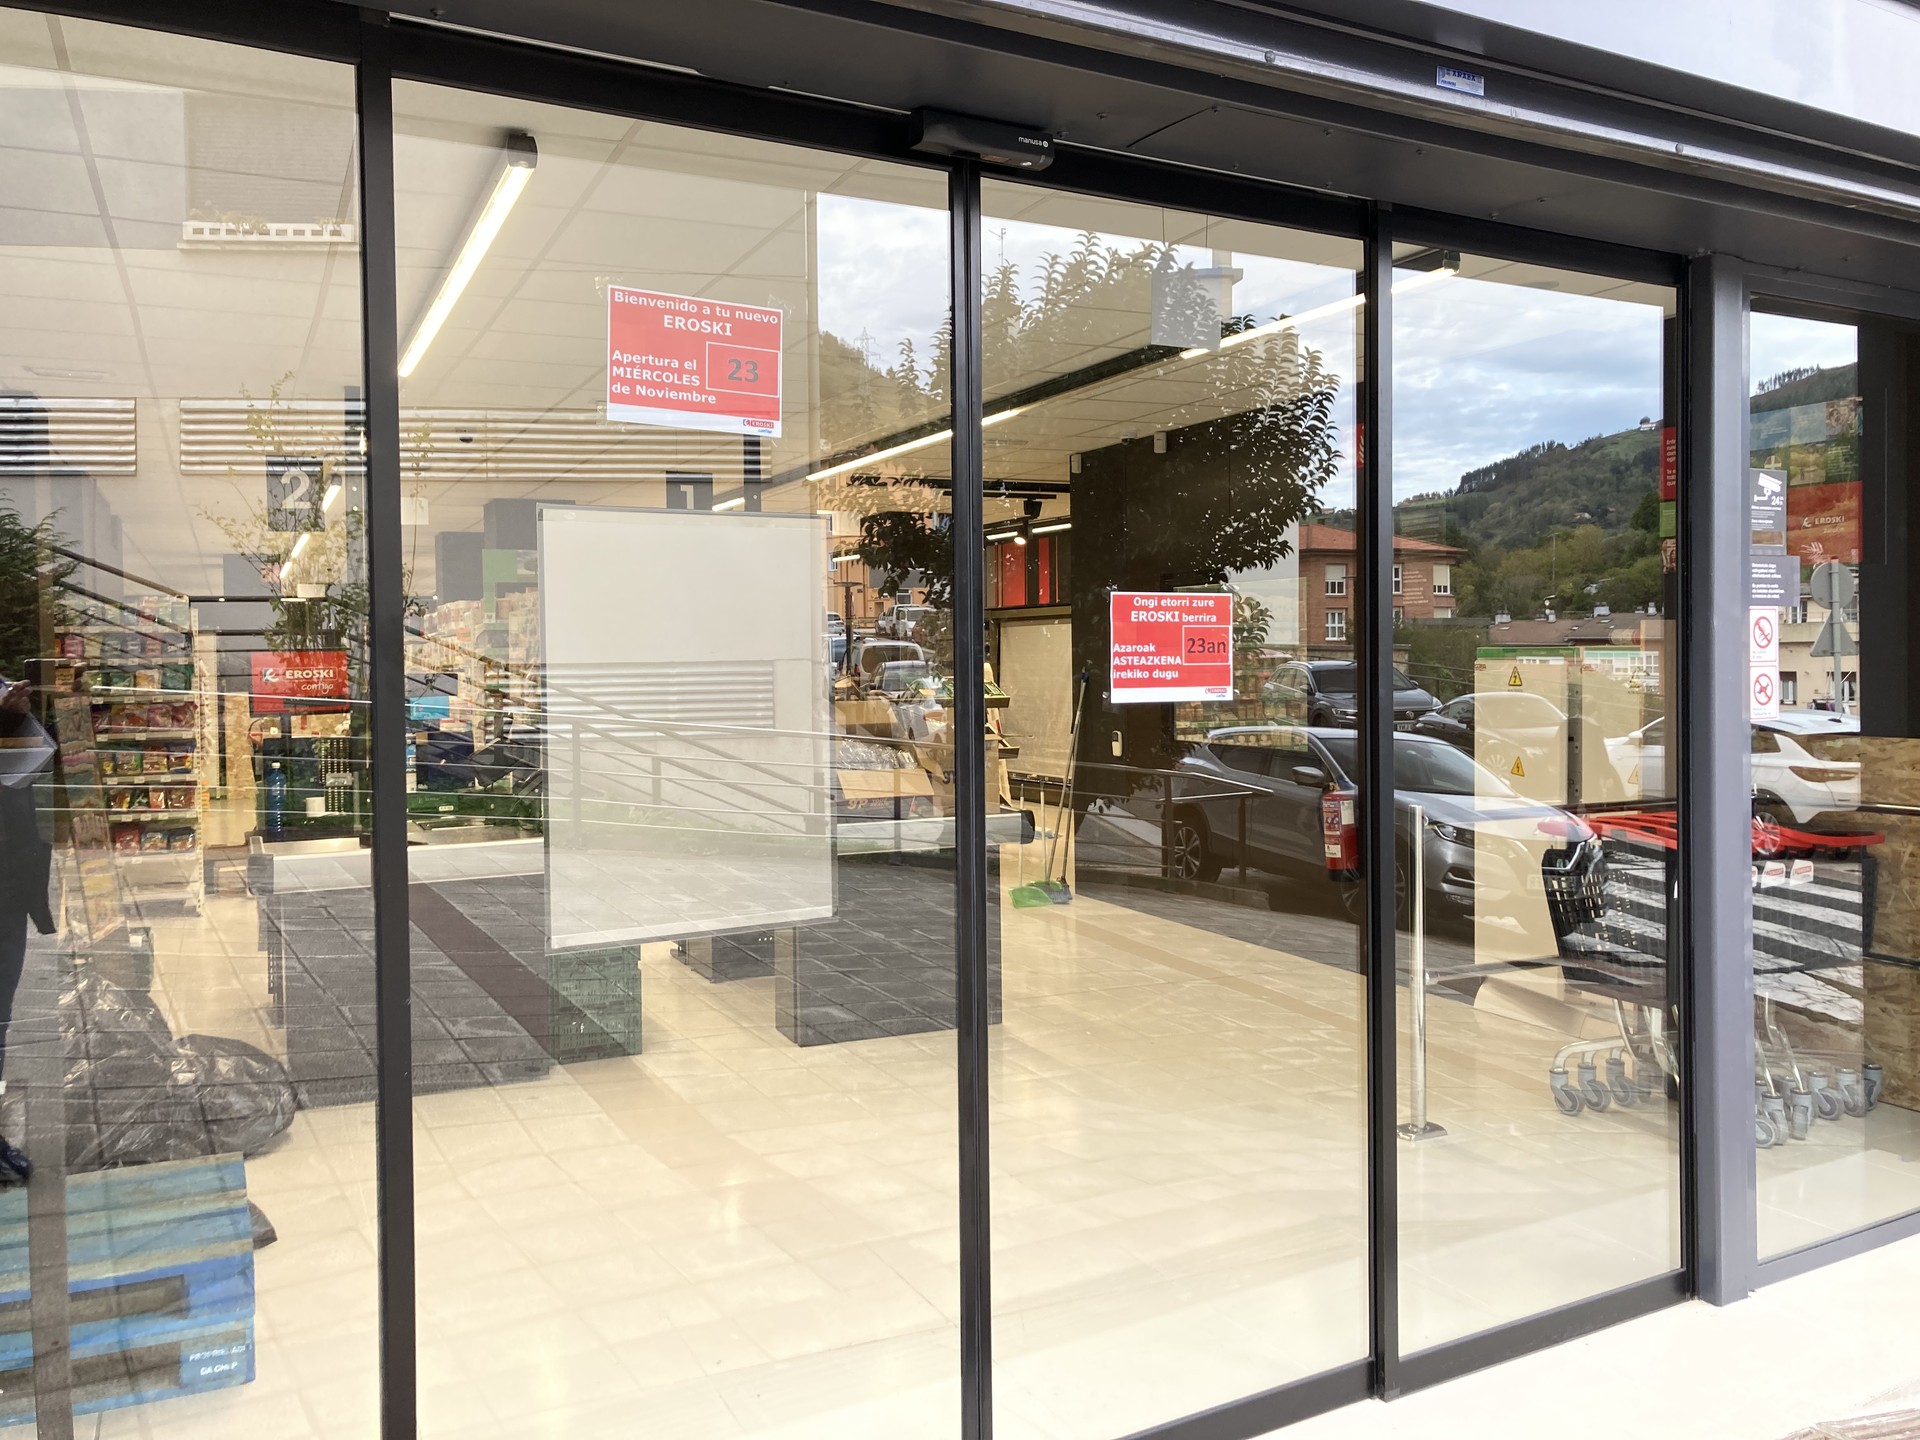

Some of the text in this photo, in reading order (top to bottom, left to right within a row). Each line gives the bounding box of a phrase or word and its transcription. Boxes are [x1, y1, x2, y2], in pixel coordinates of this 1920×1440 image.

[1018, 136, 1043, 146] manusa
[614, 291, 778, 324] Bienvenido a tu nuevo
[663, 315, 732, 336] EROSKI
[612, 350, 697, 370] Apertura el
[612, 366, 700, 386] MIÉRCOLES
[727, 358, 759, 383] 23
[612, 382, 717, 404] de Noviembre
[281, 471, 312, 509] 2
[680, 484, 695, 510] 1
[1814, 515, 1845, 525] EROSKI
[1133, 597, 1215, 608] Ongi etorri zure
[1130, 611, 1217, 622] EROSKI berrira
[1113, 643, 1156, 653] Azaroak
[1187, 638, 1227, 654] 23an
[1113, 656, 1182, 665] ASTEAZKENA
[285, 669, 334, 679] EROSKI
[1113, 669, 1179, 680] irekiko dugu
[301, 681, 334, 695] contigo
